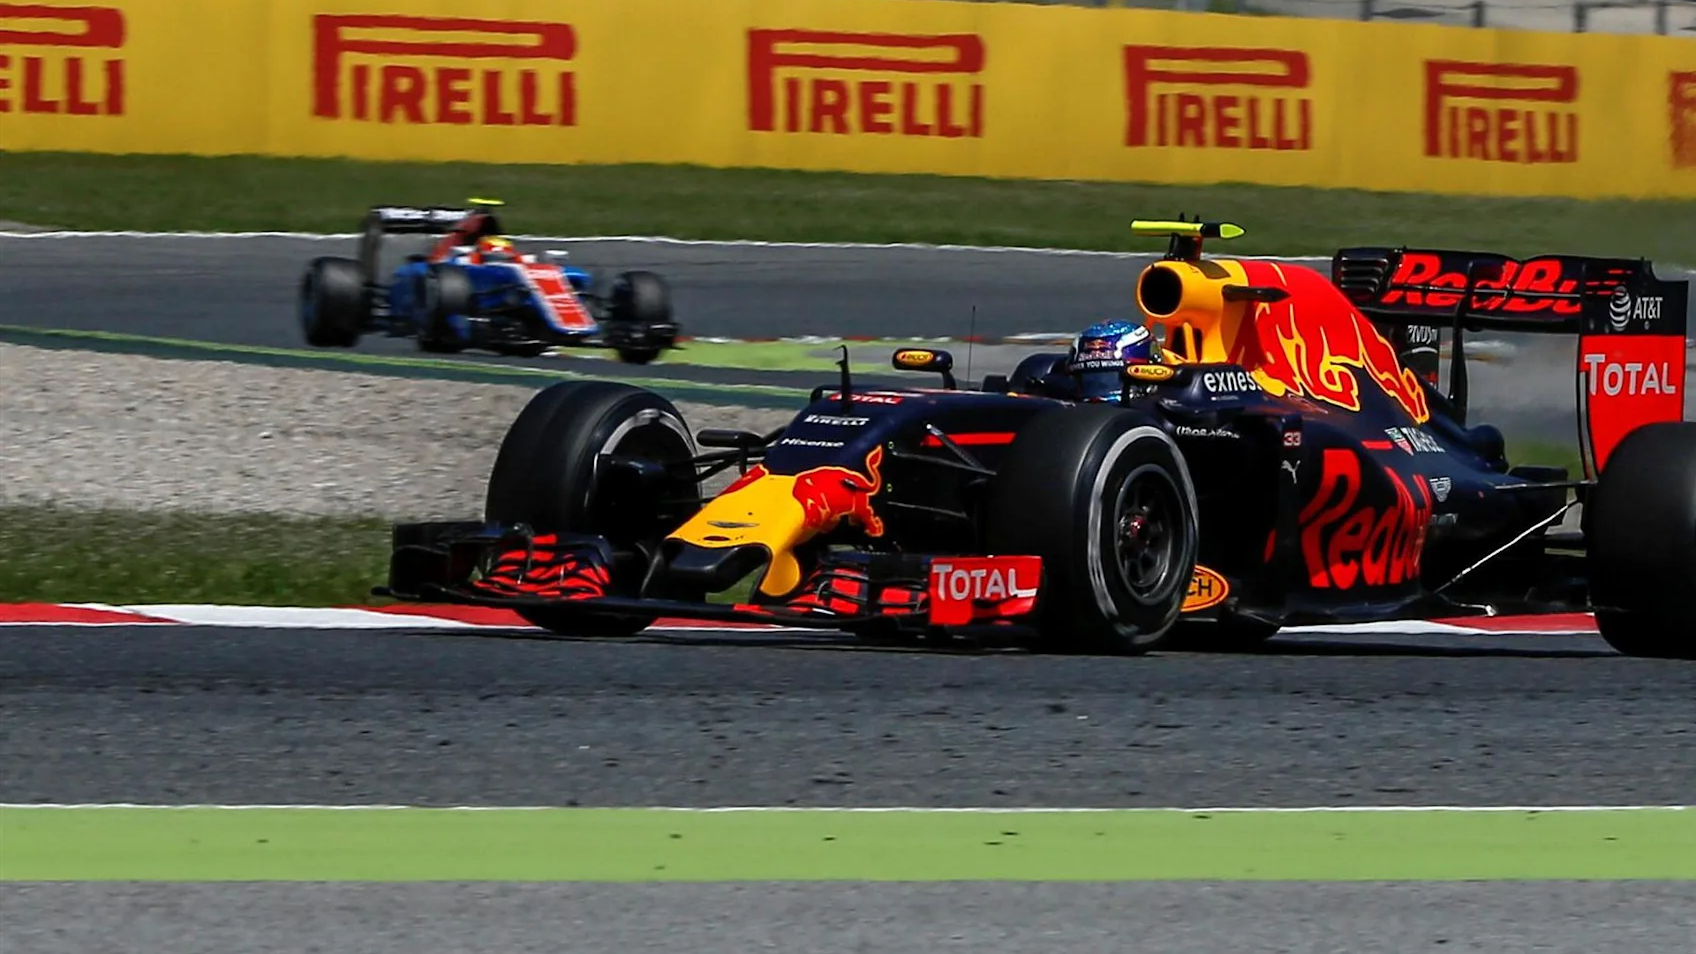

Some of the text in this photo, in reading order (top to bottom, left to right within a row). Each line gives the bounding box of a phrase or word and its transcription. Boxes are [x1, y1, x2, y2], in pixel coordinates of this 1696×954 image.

[311, 13, 579, 128] PIRELLI
[745, 27, 987, 139] PIRELLI
[1122, 43, 1314, 152] PIRELLI
[1422, 58, 1580, 164] PIRELLI
[1633, 296, 1663, 320] AT&T
[1086, 360, 1100, 368] YOU
[1140, 366, 1168, 376] RAUCH
[1584, 353, 1676, 396] TOTAL
[1203, 370, 1263, 393] exnes
[803, 414, 870, 426] PIRELLI
[781, 437, 845, 448] Hisense
[1283, 431, 1301, 446] 33
[931, 563, 1038, 601] TOTAL
